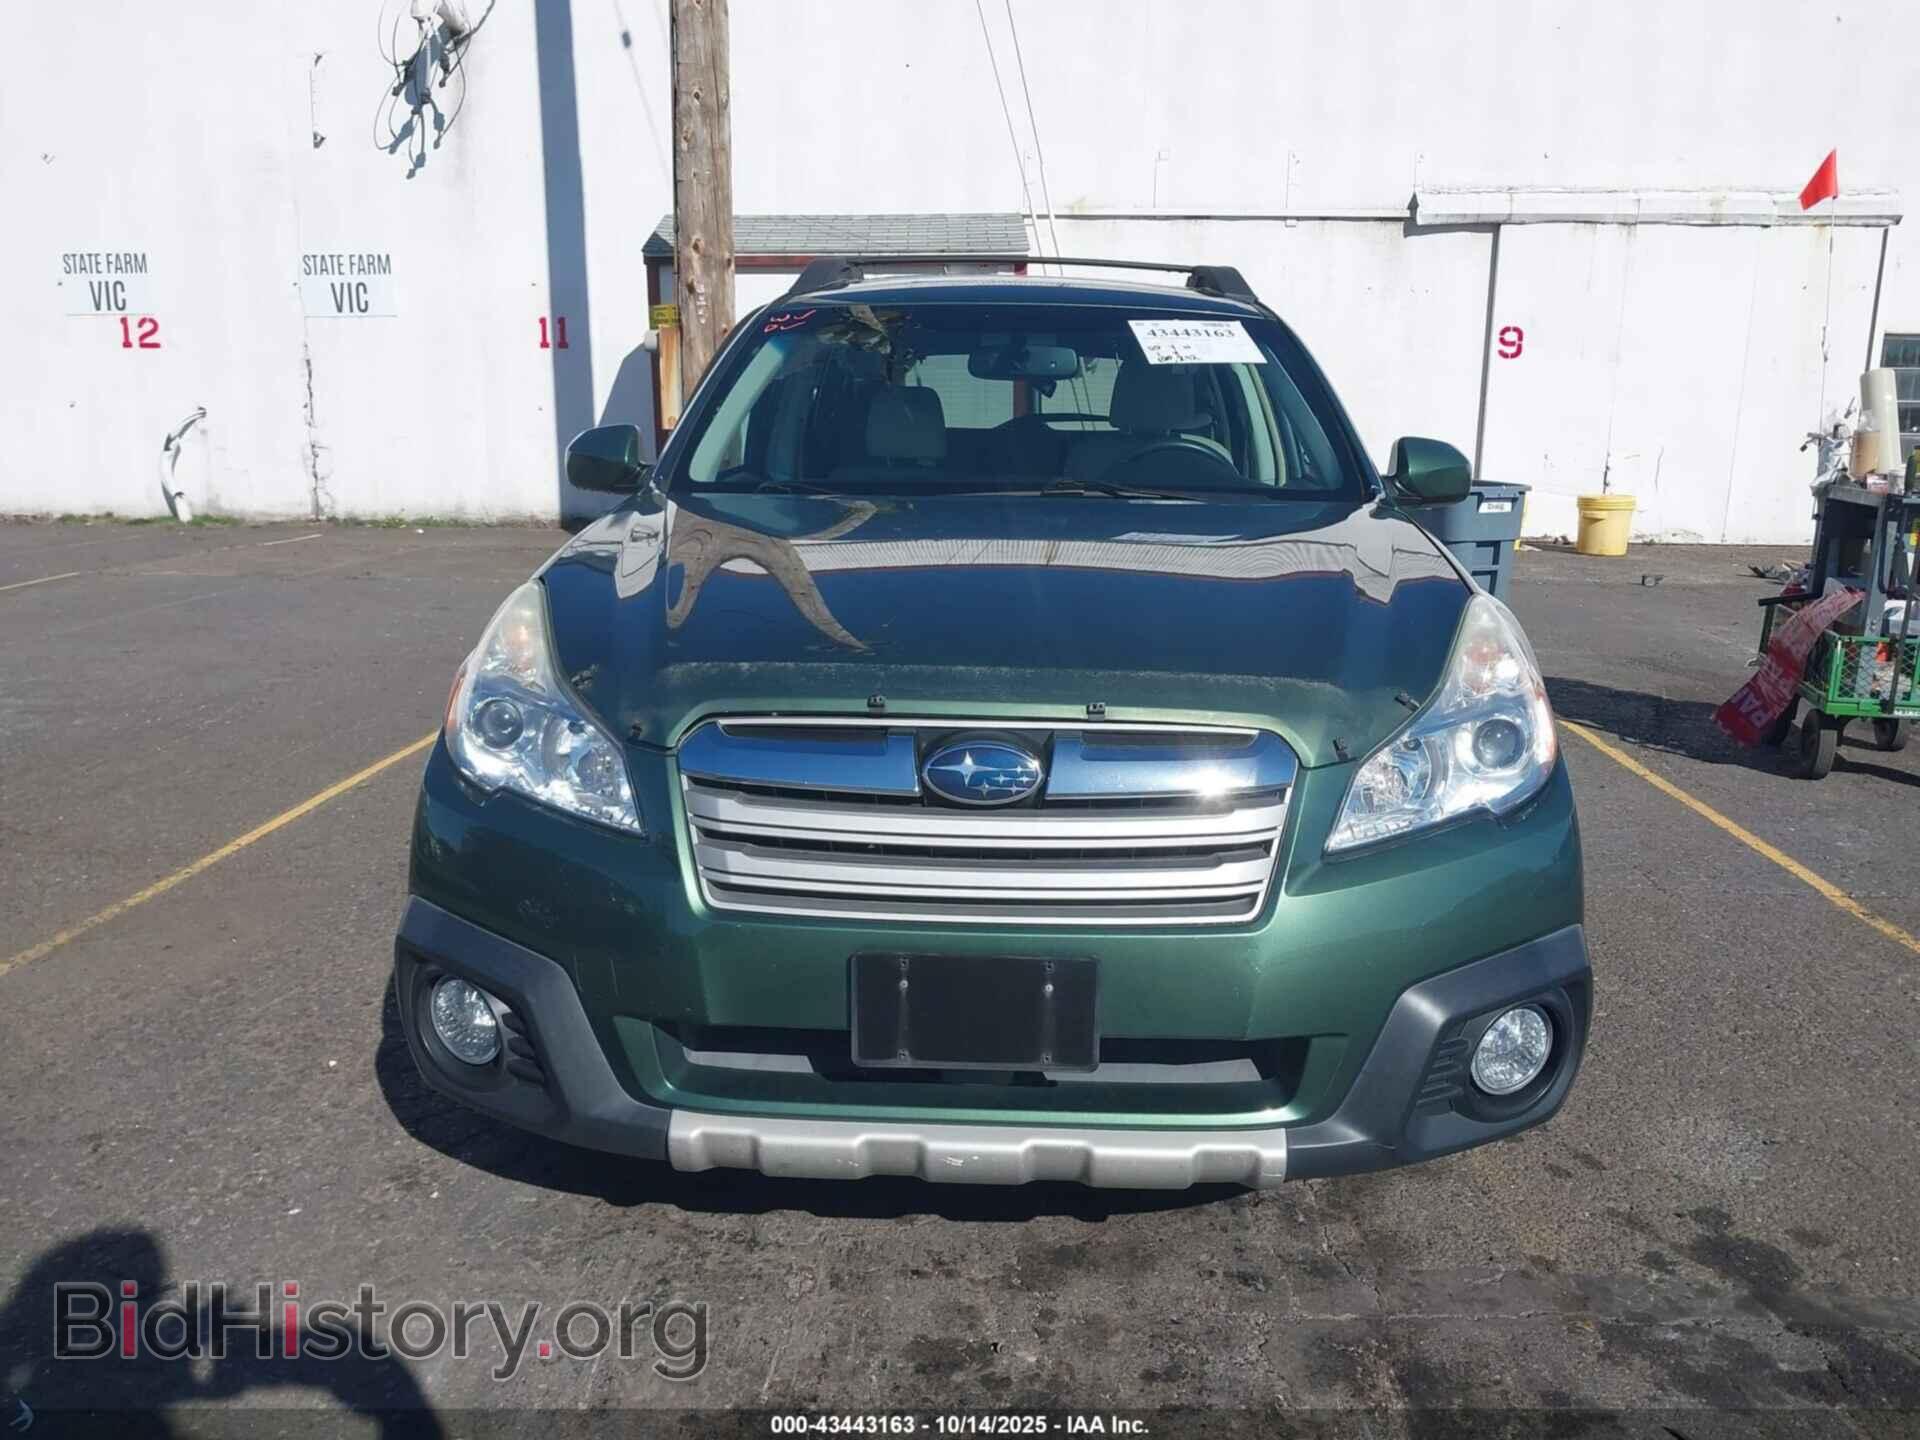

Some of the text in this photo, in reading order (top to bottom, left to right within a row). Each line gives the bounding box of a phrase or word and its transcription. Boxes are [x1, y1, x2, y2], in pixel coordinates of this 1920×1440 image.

[62, 252, 148, 274] STATE FARM
[302, 253, 392, 276] STATE FARM
[88, 280, 127, 311] VIC
[330, 282, 369, 313] VIC
[119, 316, 161, 348] 12
[538, 316, 569, 349] 11
[1146, 328, 1236, 338] 43443163
[1497, 325, 1524, 359] 9
